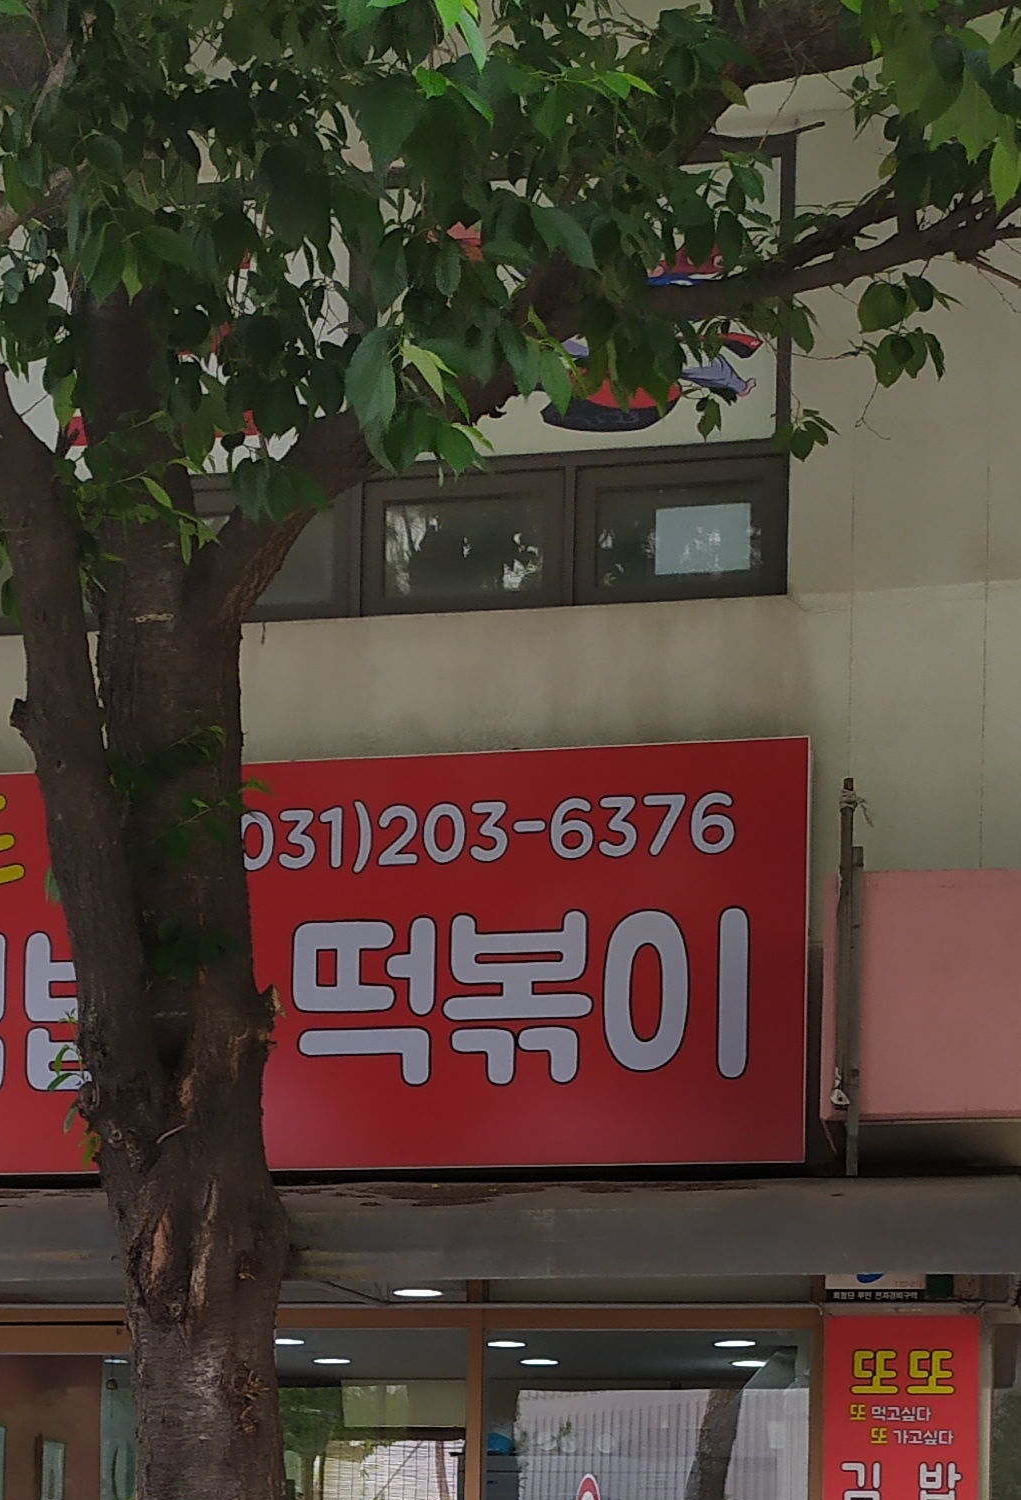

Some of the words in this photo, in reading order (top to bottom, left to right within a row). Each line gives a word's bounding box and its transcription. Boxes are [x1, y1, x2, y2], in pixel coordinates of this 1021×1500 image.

[240, 790, 736, 873] 031)203-6376
[291, 905, 751, 1086] 떡볶이
[849, 1404, 866, 1421] 또
[871, 1405, 931, 1422] 먹고싶다
[870, 1427, 888, 1444] 또
[893, 1429, 954, 1446] 가고싶다
